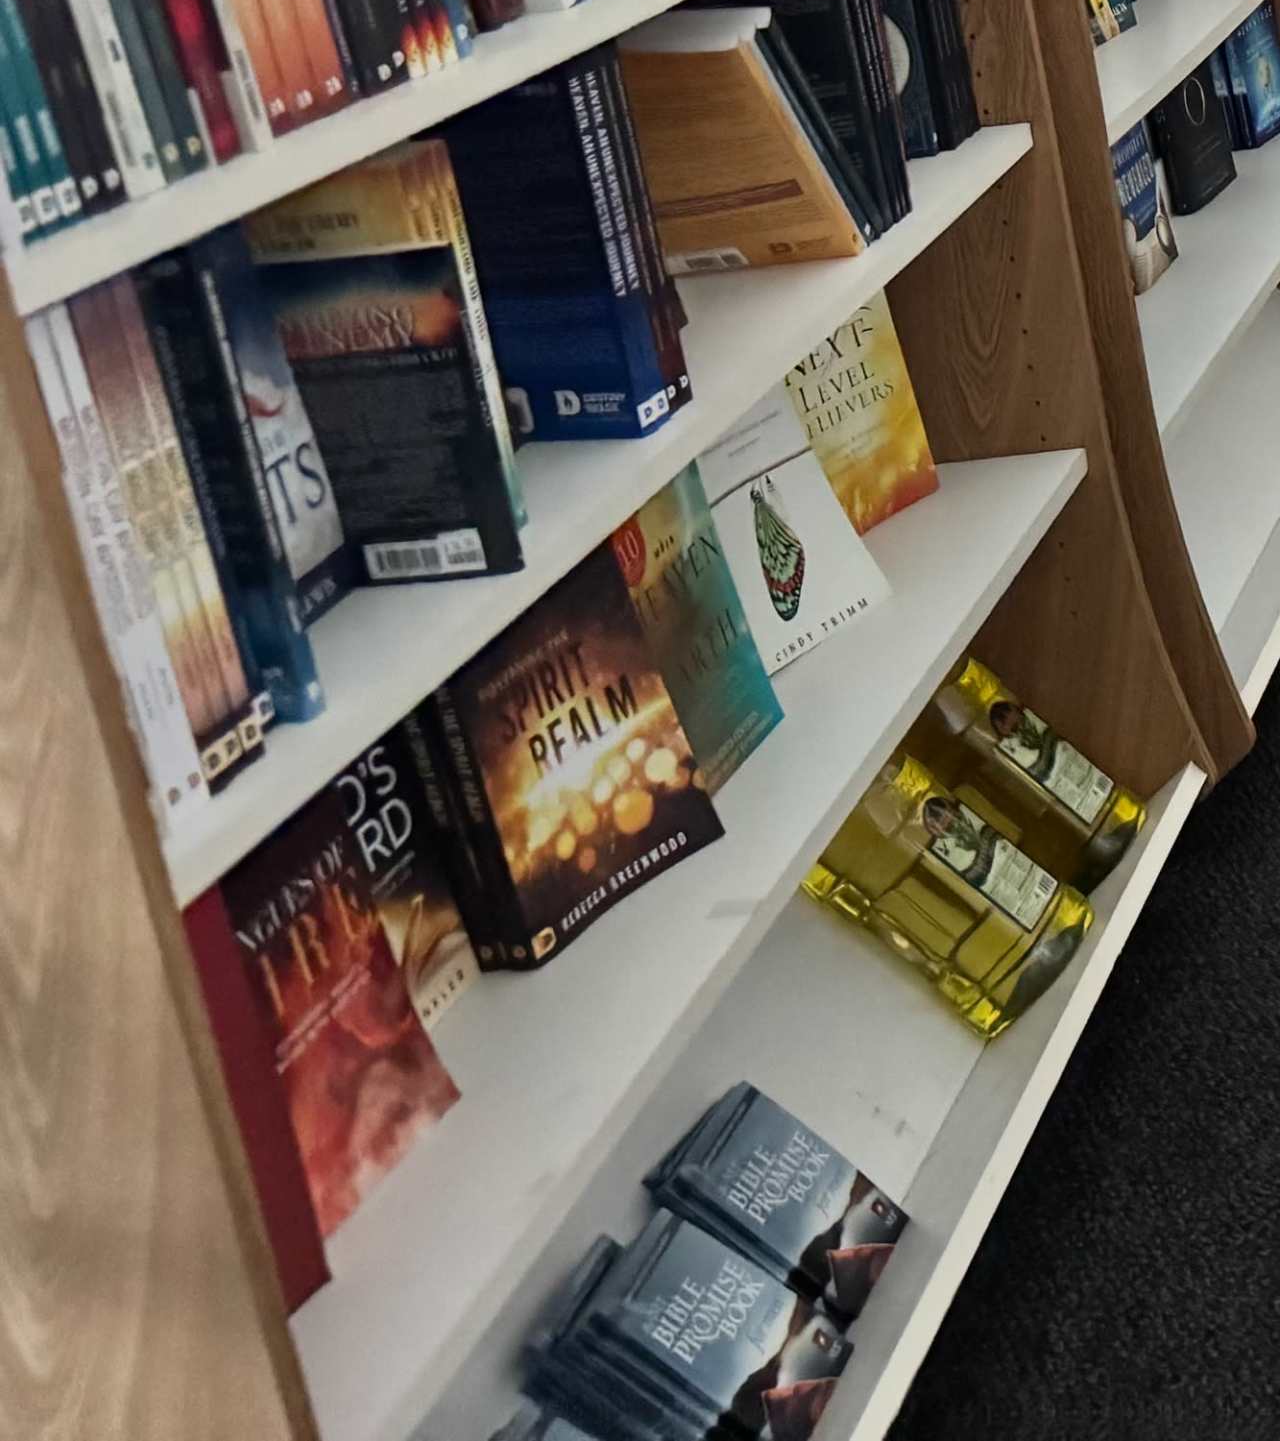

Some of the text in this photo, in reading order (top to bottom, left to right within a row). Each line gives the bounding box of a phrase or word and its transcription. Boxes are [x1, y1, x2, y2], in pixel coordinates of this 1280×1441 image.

[798, 360, 877, 415] LEVEL
[500, 640, 590, 742] SPIRIT
[528, 674, 640, 778] REALM
[725, 1143, 780, 1211] BIBLE
[744, 1132, 817, 1228] PROMISE
[785, 1143, 831, 1203] BOOK
[650, 1274, 706, 1351] BIBLE
[673, 1259, 746, 1366] PROMISE
[719, 1273, 767, 1344] BOOK
